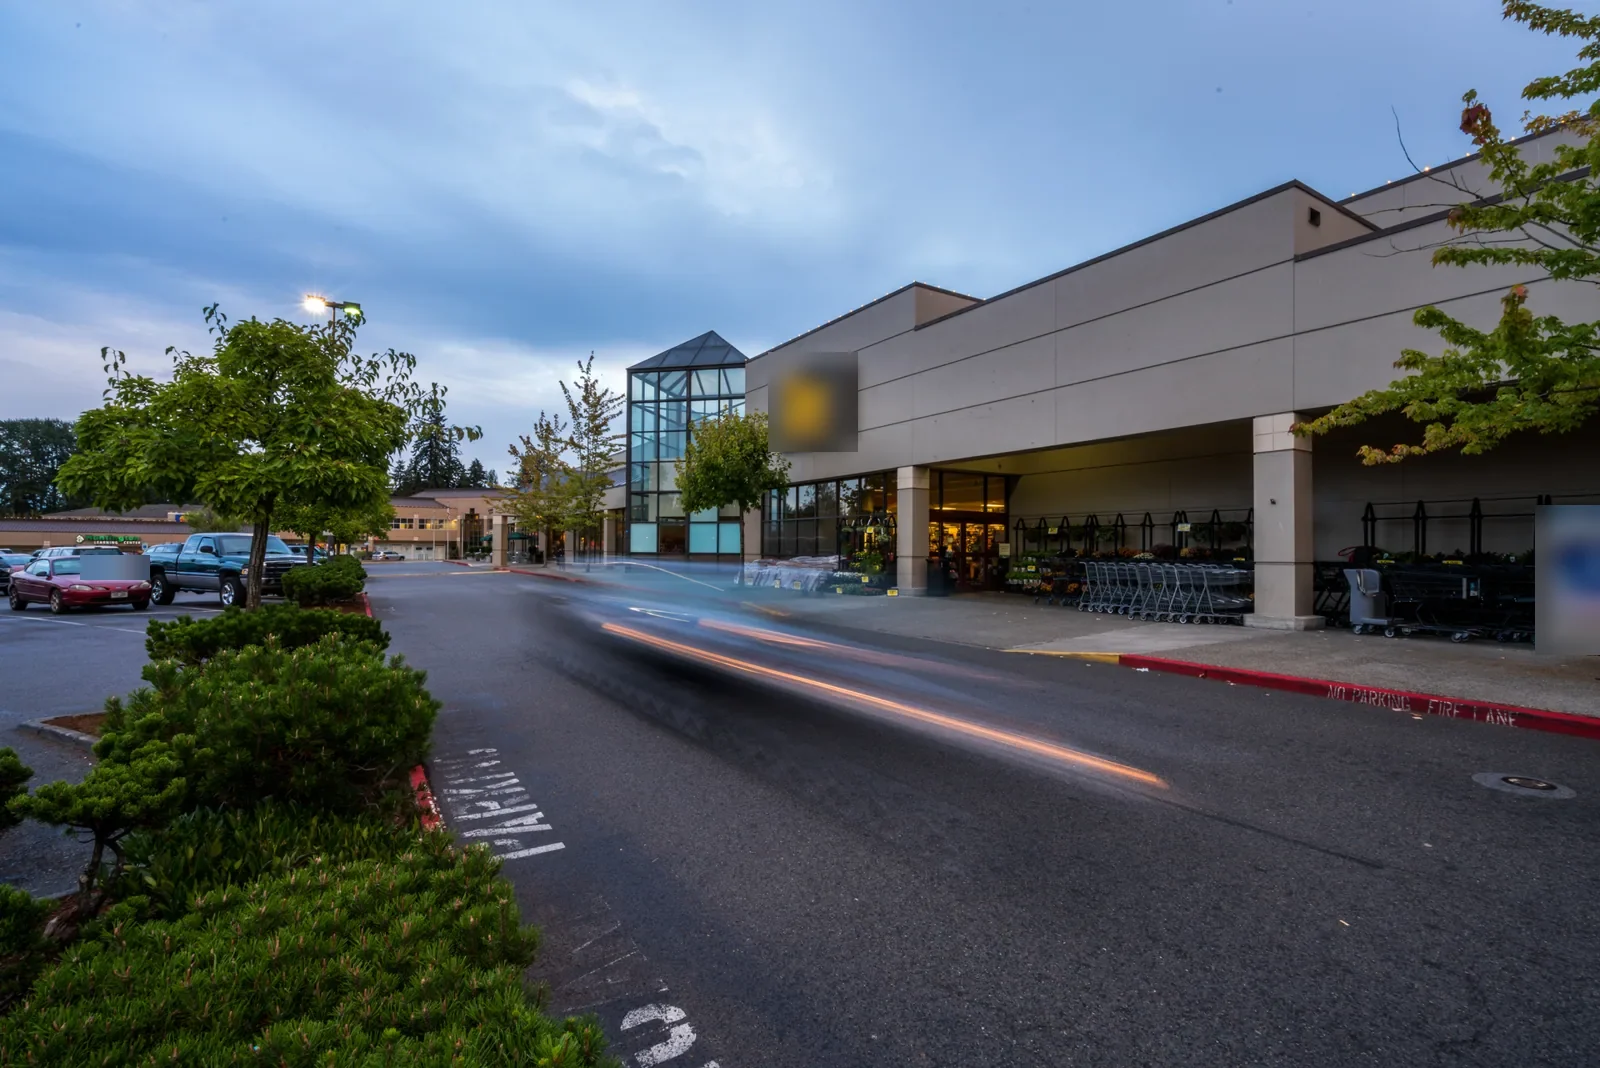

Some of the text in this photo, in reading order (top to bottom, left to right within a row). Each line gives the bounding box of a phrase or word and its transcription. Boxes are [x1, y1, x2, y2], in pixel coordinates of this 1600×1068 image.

[1327, 684, 1346, 700] NO
[1352, 687, 1411, 712] PARKING
[1427, 699, 1464, 718] FIRE
